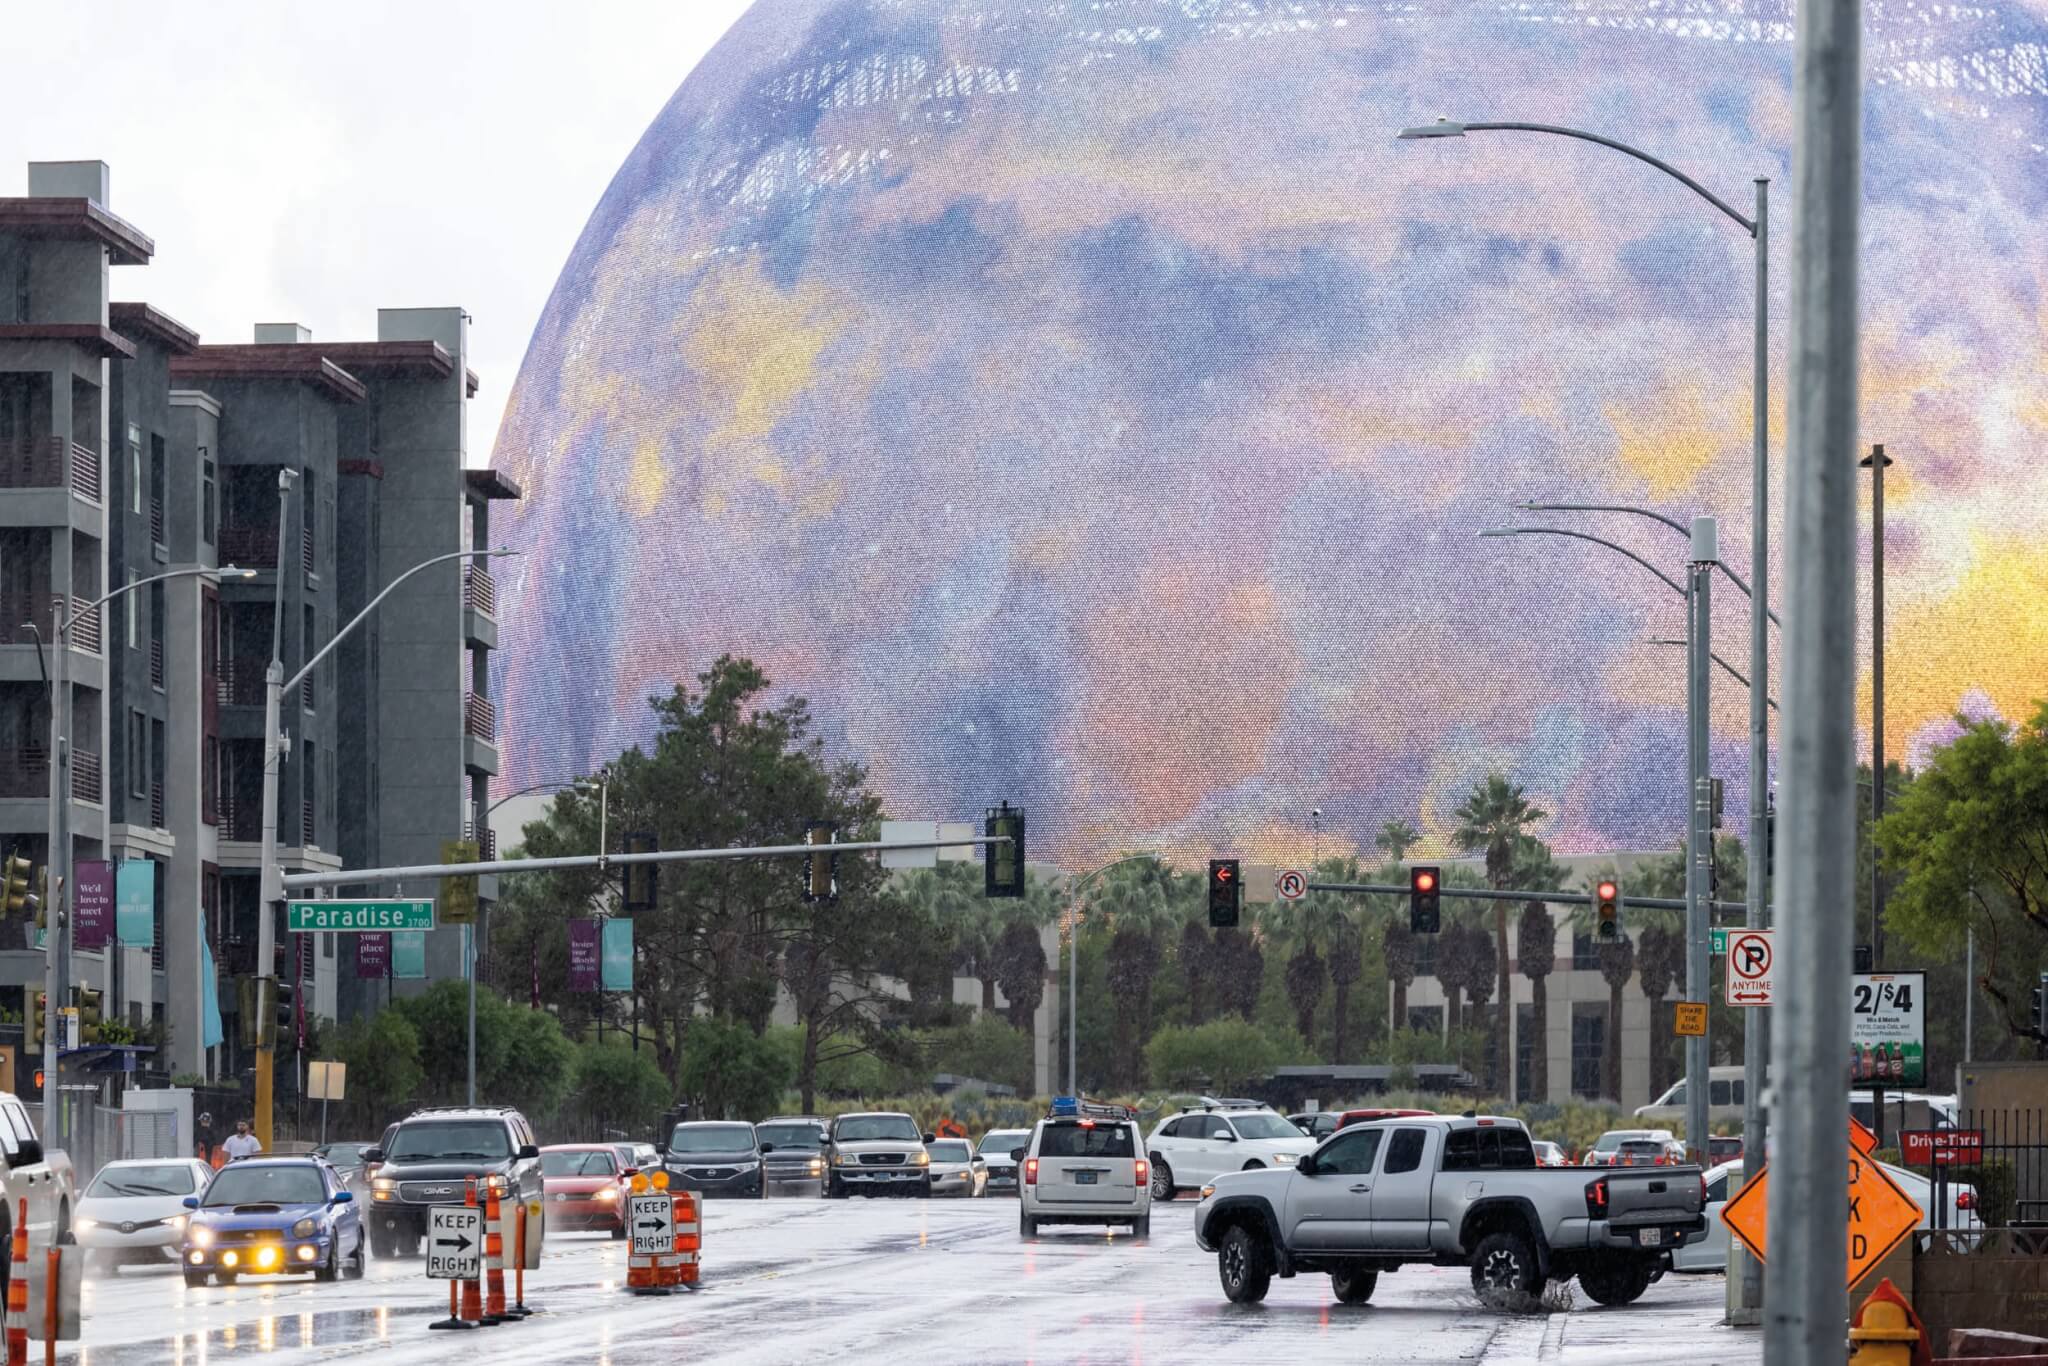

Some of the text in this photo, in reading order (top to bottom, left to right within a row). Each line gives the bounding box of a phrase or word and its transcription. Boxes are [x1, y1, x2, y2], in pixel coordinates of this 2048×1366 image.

[80, 884, 101, 893] We'd
[80, 896, 108, 904] love to
[80, 907, 101, 916] meet
[291, 904, 296, 913] S
[412, 903, 424, 912] RD
[301, 906, 404, 926] Paradise
[80, 919, 99, 928] you.
[408, 918, 430, 928] 3700
[360, 943, 384, 953] place
[361, 956, 383, 964] here.
[1732, 981, 1772, 990] ANYTIME
[1854, 983, 1912, 1016] 2/$4
[1909, 1134, 1978, 1147] Drive-Thru
[635, 1201, 668, 1214] KEEP
[434, 1215, 476, 1228] KEEP
[636, 1236, 670, 1249] RIGHT
[431, 1257, 477, 1271] RIGHT
